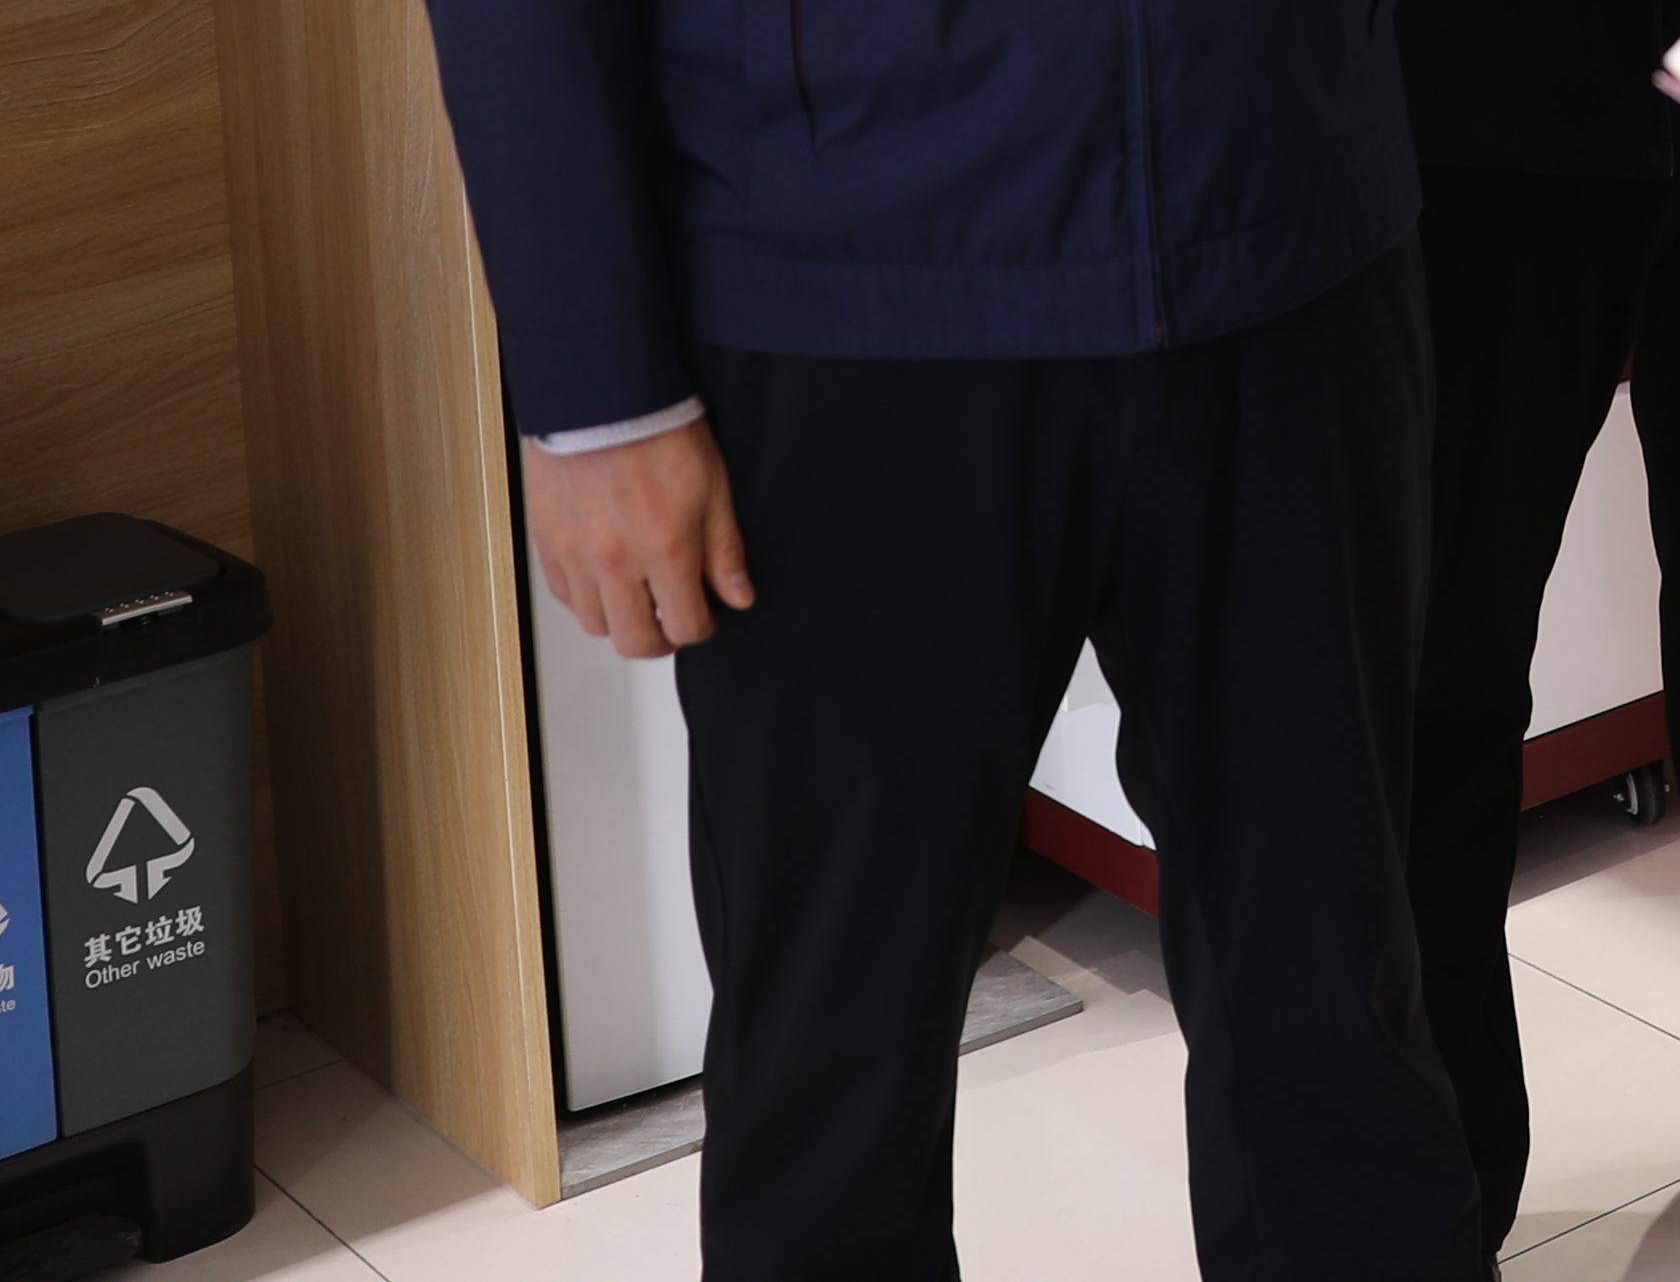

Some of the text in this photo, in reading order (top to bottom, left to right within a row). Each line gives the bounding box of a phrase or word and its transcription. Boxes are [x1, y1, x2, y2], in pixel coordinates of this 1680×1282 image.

[83, 906, 205, 968] 其它垃圾
[85, 940, 205, 989] Other waste
